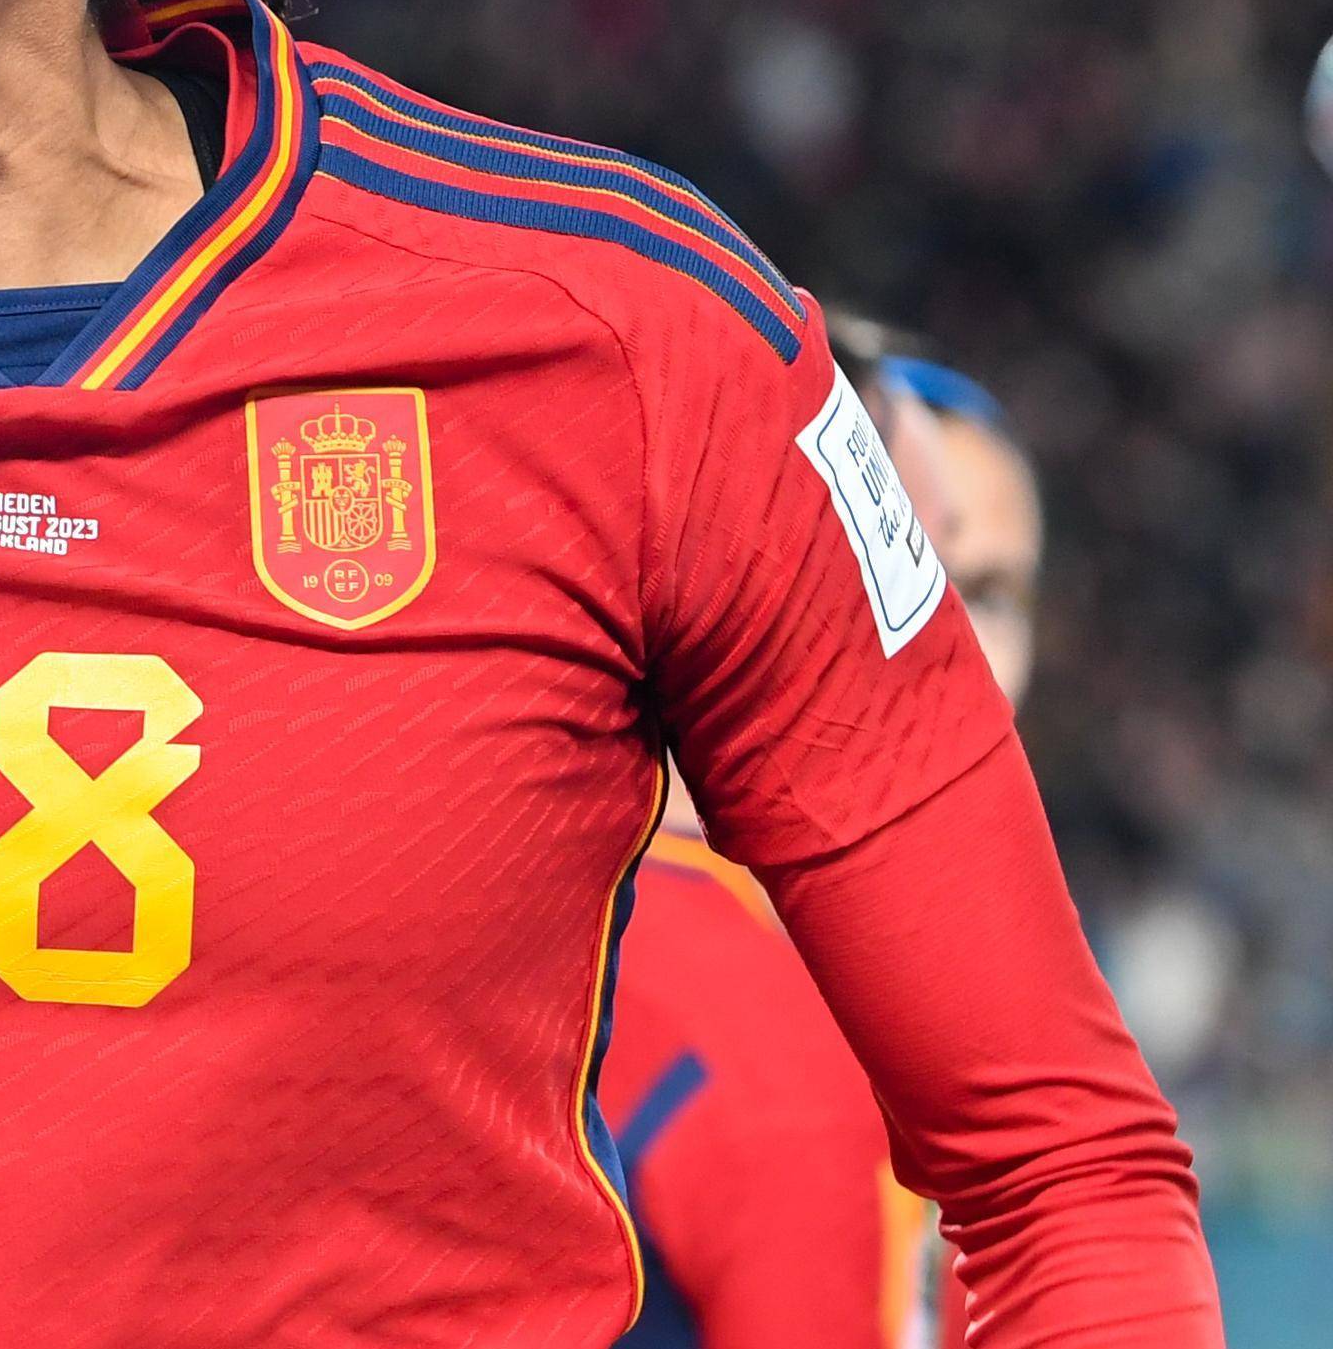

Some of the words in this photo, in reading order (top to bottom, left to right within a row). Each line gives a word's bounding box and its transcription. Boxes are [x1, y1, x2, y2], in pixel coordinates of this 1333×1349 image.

[45, 518, 99, 540] 2023
[303, 575, 319, 589] 19
[375, 574, 393, 587] 09
